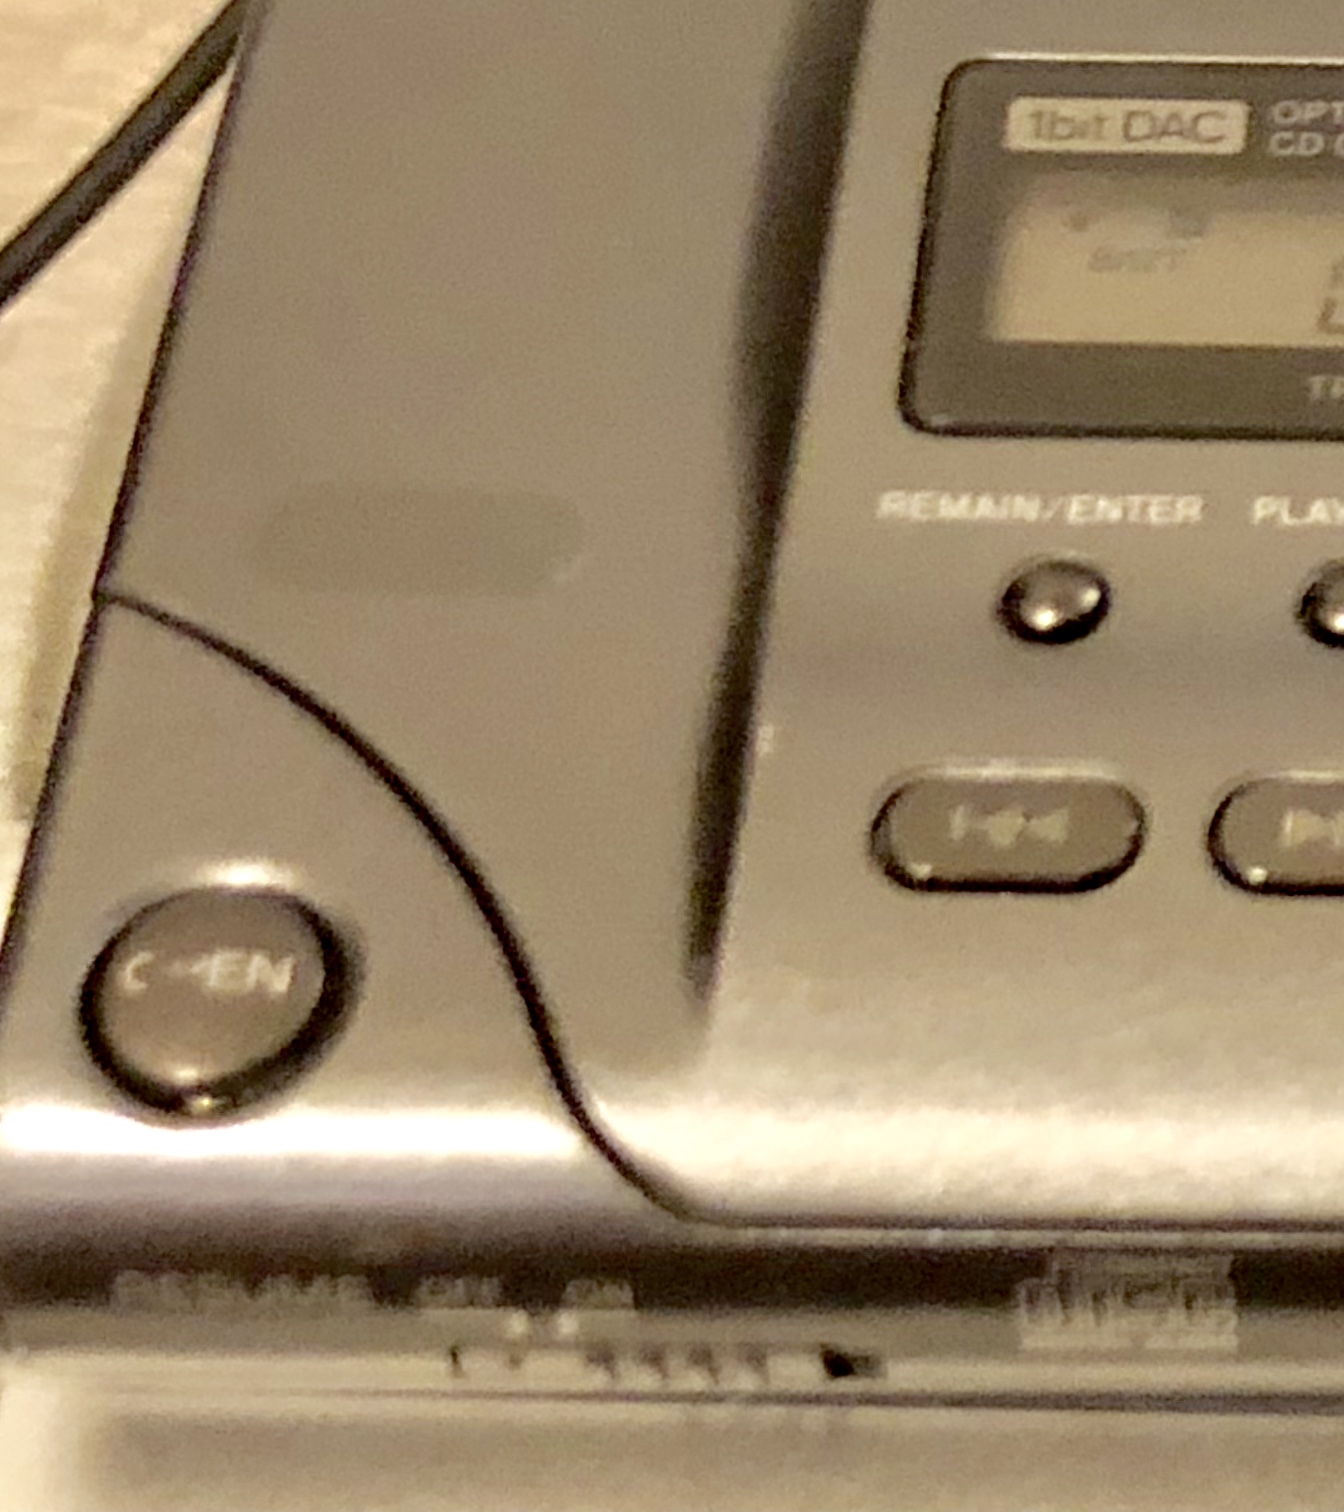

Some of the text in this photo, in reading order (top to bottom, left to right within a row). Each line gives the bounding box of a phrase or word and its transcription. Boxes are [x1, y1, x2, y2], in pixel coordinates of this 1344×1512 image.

[1122, 108, 1228, 145] DAC
[1268, 130, 1326, 158] CD
[876, 489, 1206, 525] REMAIN/ENTER
